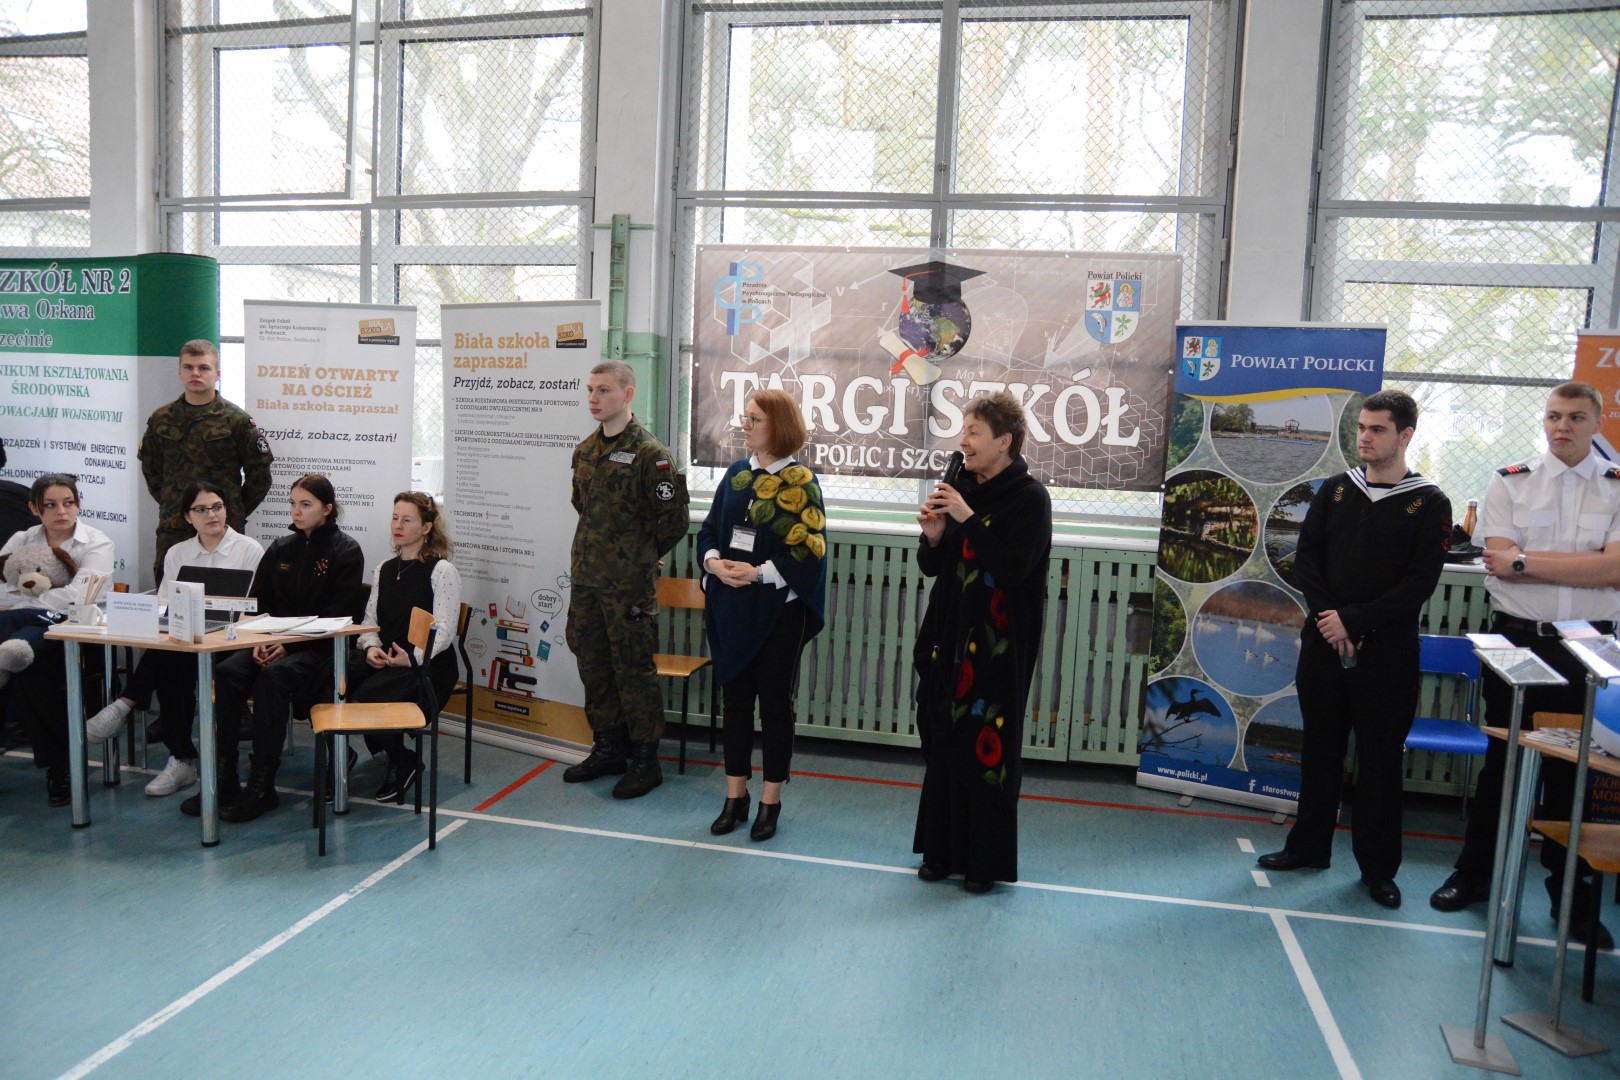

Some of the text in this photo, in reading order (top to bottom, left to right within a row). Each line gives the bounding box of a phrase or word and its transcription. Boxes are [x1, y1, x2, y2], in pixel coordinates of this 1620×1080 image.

[81, 268, 115, 294] NR
[119, 268, 131, 294] 2
[1087, 270, 1142, 280] Powiat Policki
[0, 299, 95, 320] wa Orkana
[454, 332, 550, 349] Biała szkoła
[453, 352, 528, 372] zaprasza!
[1230, 354, 1375, 372] POWIAT POLICKI
[43, 366, 129, 381] KSZTAŁTOWANIA
[257, 364, 399, 382] DZIEŃ OTWARTY
[12, 380, 90, 398] ŚRODOWISKA
[282, 382, 372, 398] NA OŚCIEŻ
[453, 376, 580, 390] Przyjdź, zobacz, zostań!
[257, 398, 398, 416] Biała szkoła zaprasza!
[720, 371, 911, 434] TRGI
[62, 408, 123, 422] WOJSKOWYMI
[258, 428, 397, 443] Przyjdź, zobacz, zostań!
[50, 440, 86, 452] SYSTEMÓW
[91, 444, 126, 456] ENERGETYKI
[814, 444, 882, 467] POLIC
[887, 448, 895, 468] I
[84, 457, 126, 470] ODNAWIALNEJ
[96, 511, 127, 523] WIEJSKICH
[120, 558, 125, 570] 8
[538, 594, 557, 604] dobry
[1157, 766, 1208, 782] www.policki.pl
